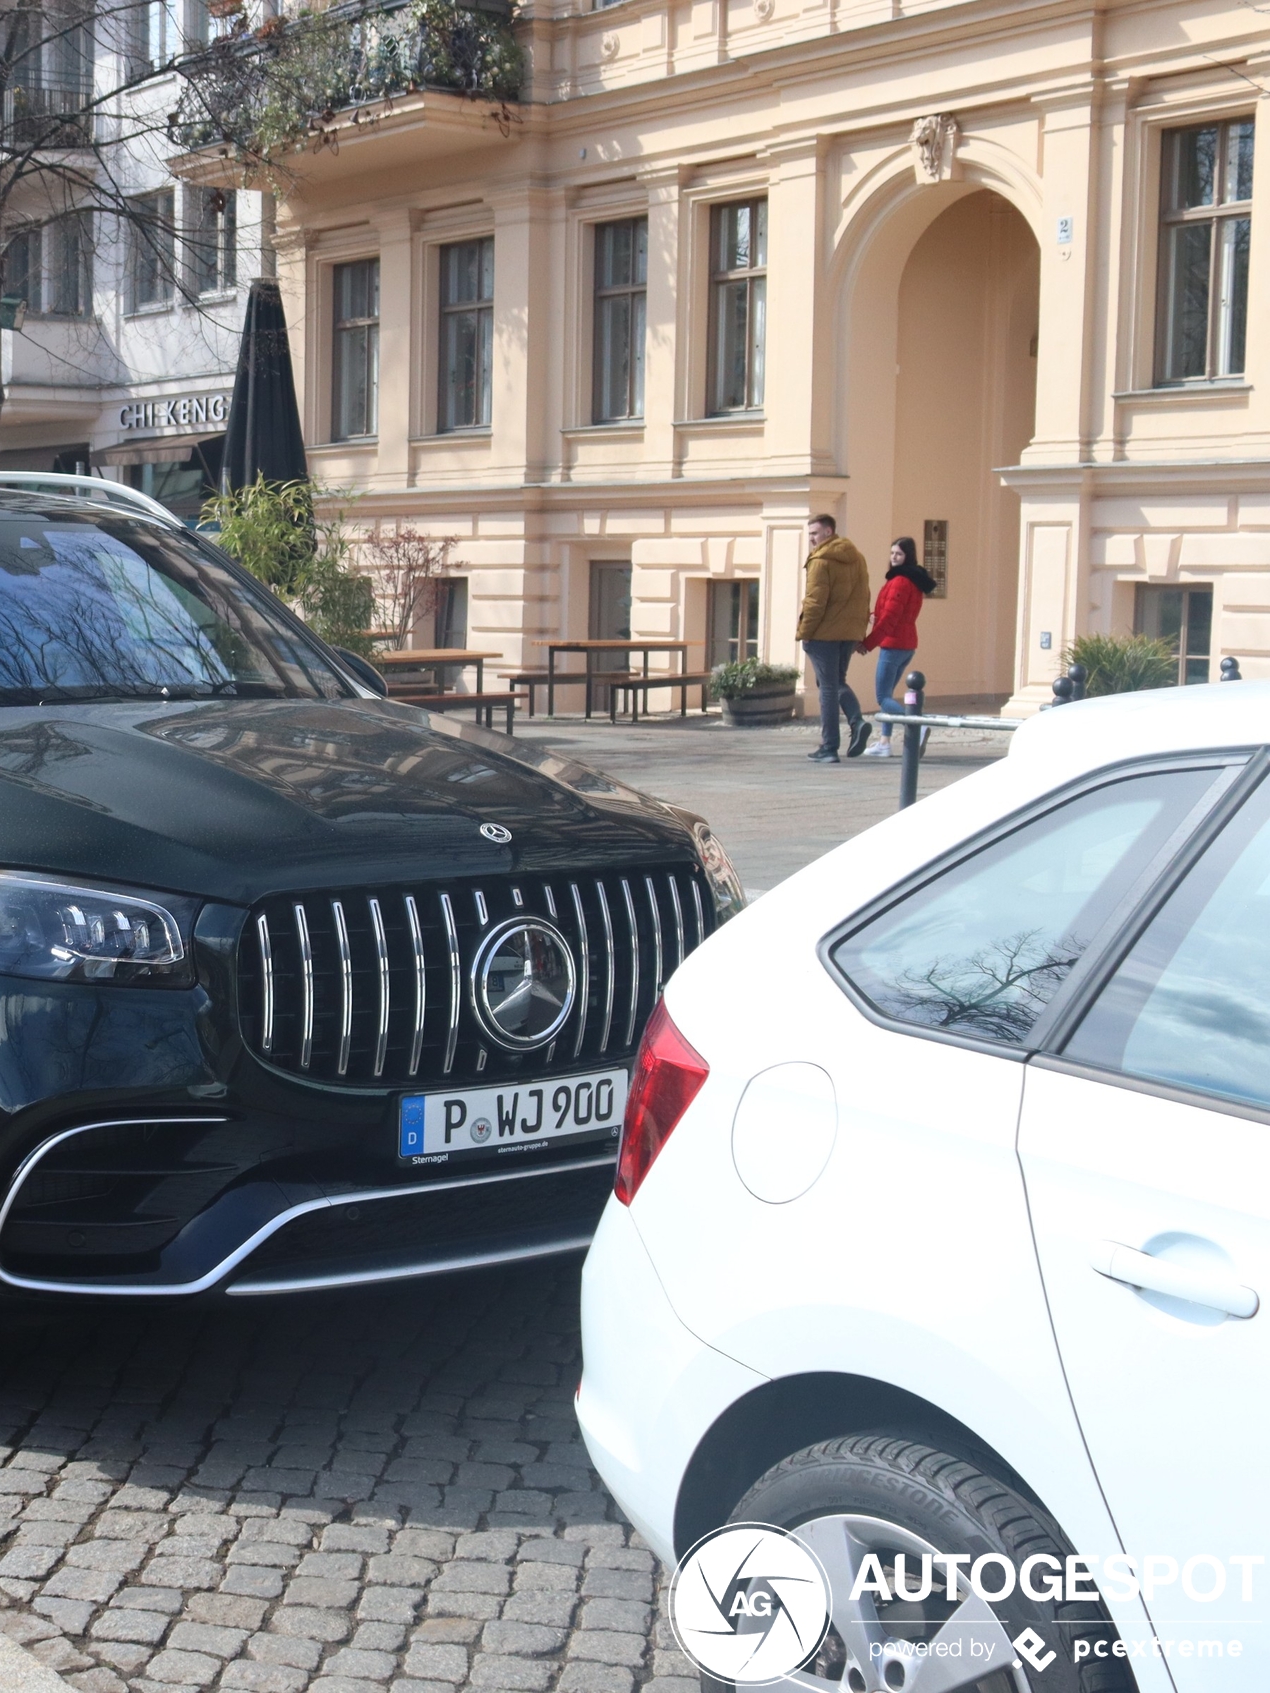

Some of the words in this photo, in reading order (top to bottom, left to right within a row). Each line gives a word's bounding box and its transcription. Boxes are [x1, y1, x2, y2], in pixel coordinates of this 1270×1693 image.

[1060, 219, 1069, 234] 2
[119, 402, 154, 429] CHI
[166, 395, 225, 425] KENG
[444, 1099, 468, 1144] P
[496, 1088, 544, 1137] WJ
[552, 1078, 614, 1129] 900
[408, 1131, 417, 1145] D
[497, 1140, 549, 1154] sternauto-gruppe.de
[412, 1153, 449, 1165] Sternagel
[804, 1467, 959, 1526] BRIDGESTONE
